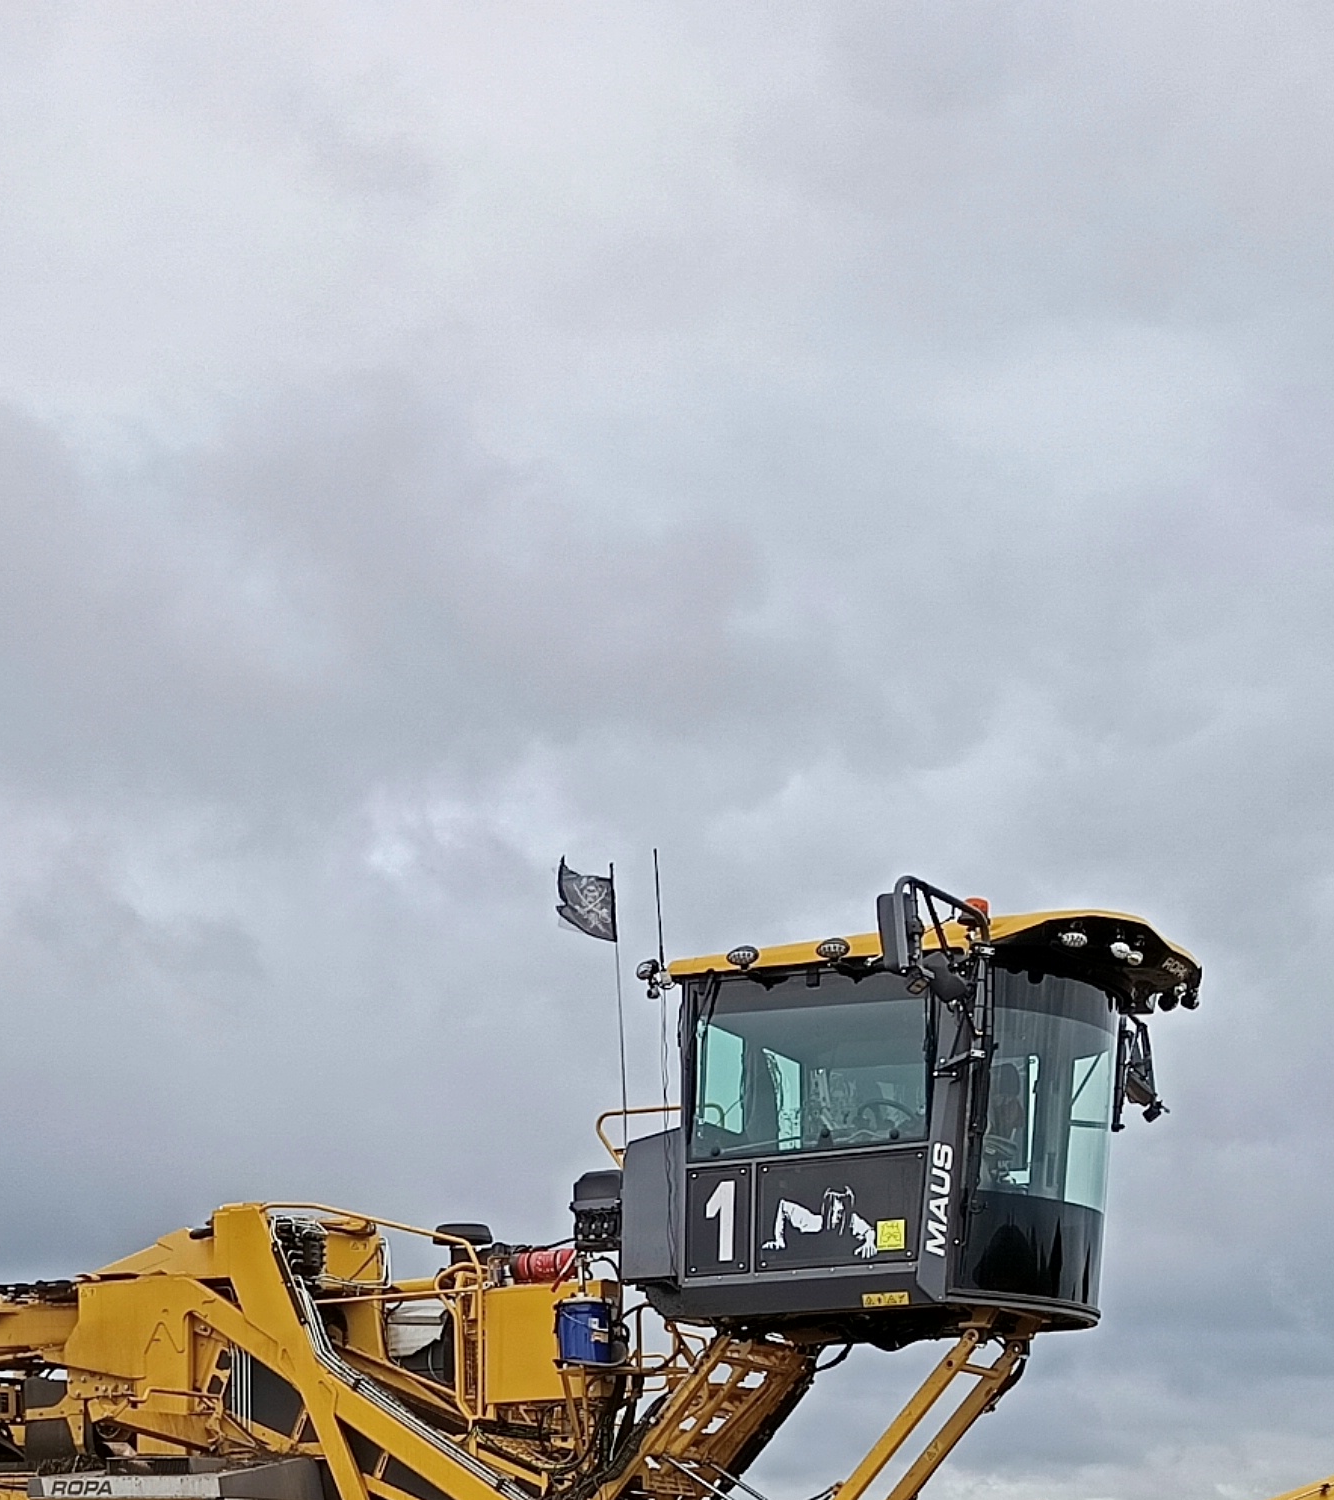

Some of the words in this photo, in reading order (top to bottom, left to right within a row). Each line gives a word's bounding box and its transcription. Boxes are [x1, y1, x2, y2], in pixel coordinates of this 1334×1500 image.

[705, 1180, 735, 1261] 1
[925, 1142, 954, 1257] MAUS
[51, 1481, 113, 1495] ROPA
